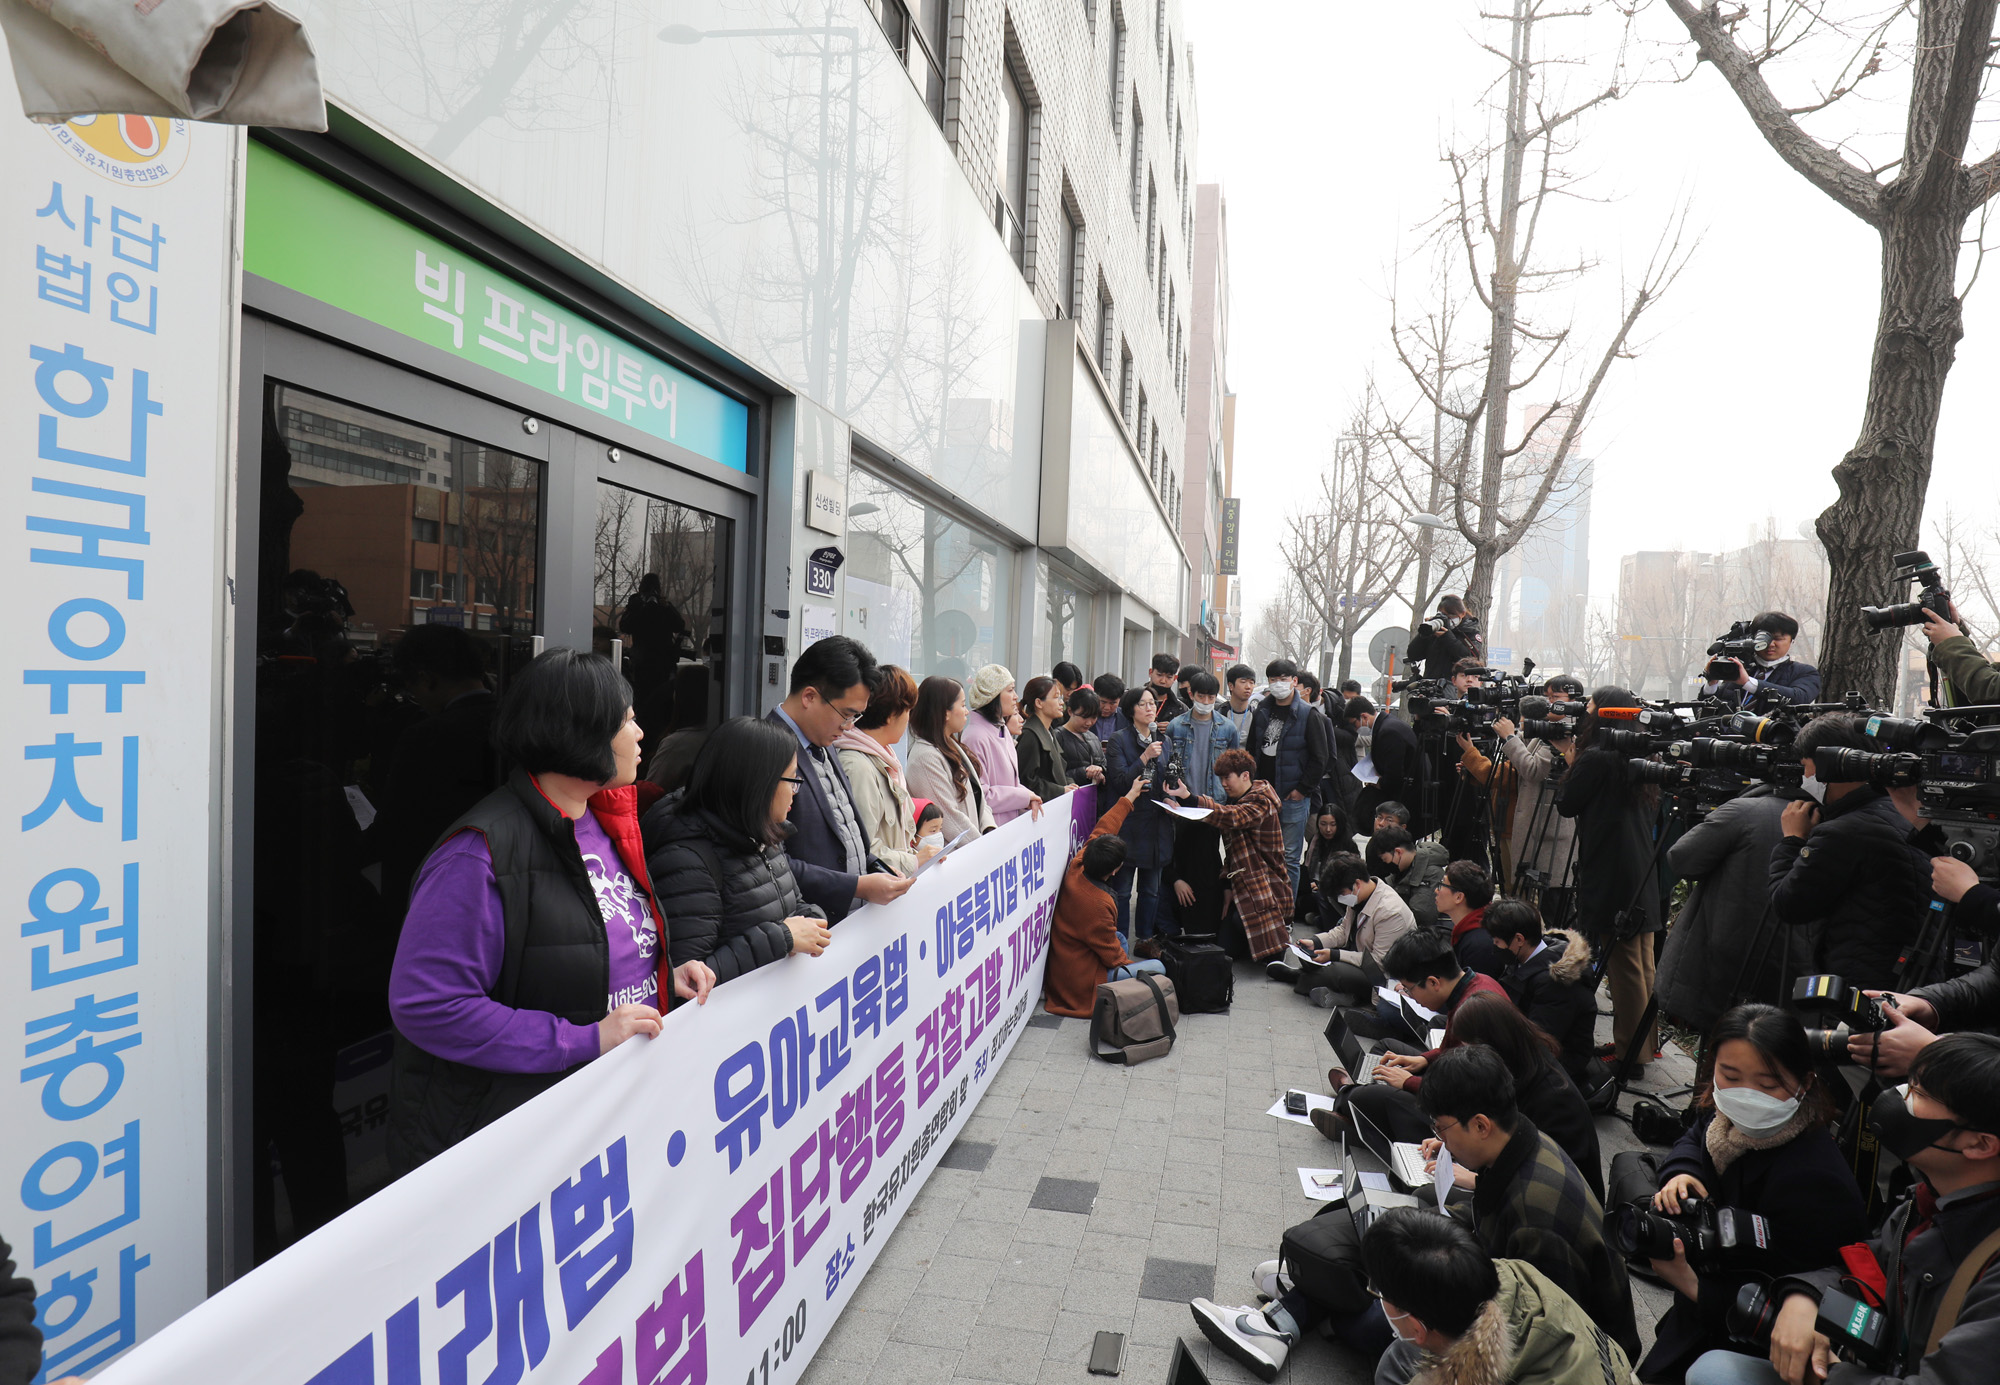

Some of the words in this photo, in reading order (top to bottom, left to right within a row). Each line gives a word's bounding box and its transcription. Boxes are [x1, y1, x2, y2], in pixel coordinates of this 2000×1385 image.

[36, 181, 167, 273] 사단
[36, 244, 158, 335] 법인
[415, 249, 466, 350] 빅
[478, 285, 677, 439] 프라임투어
[815, 492, 841, 517] 신성빌딩
[812, 566, 831, 591] 330
[1553, 703, 1565, 712] KBS
[713, 933, 909, 1175] 유아교육법
[936, 855, 1018, 979] 아동복지법
[1021, 837, 1045, 900] 위반
[730, 1042, 906, 1338] 집단행동
[915, 946, 1004, 1110] 검찰고발
[825, 1232, 855, 1301] 장소
[862, 1086, 959, 1246] 한국유치원총연합회
[959, 1074, 969, 1107] 앞
[973, 1046, 989, 1085] 주최
